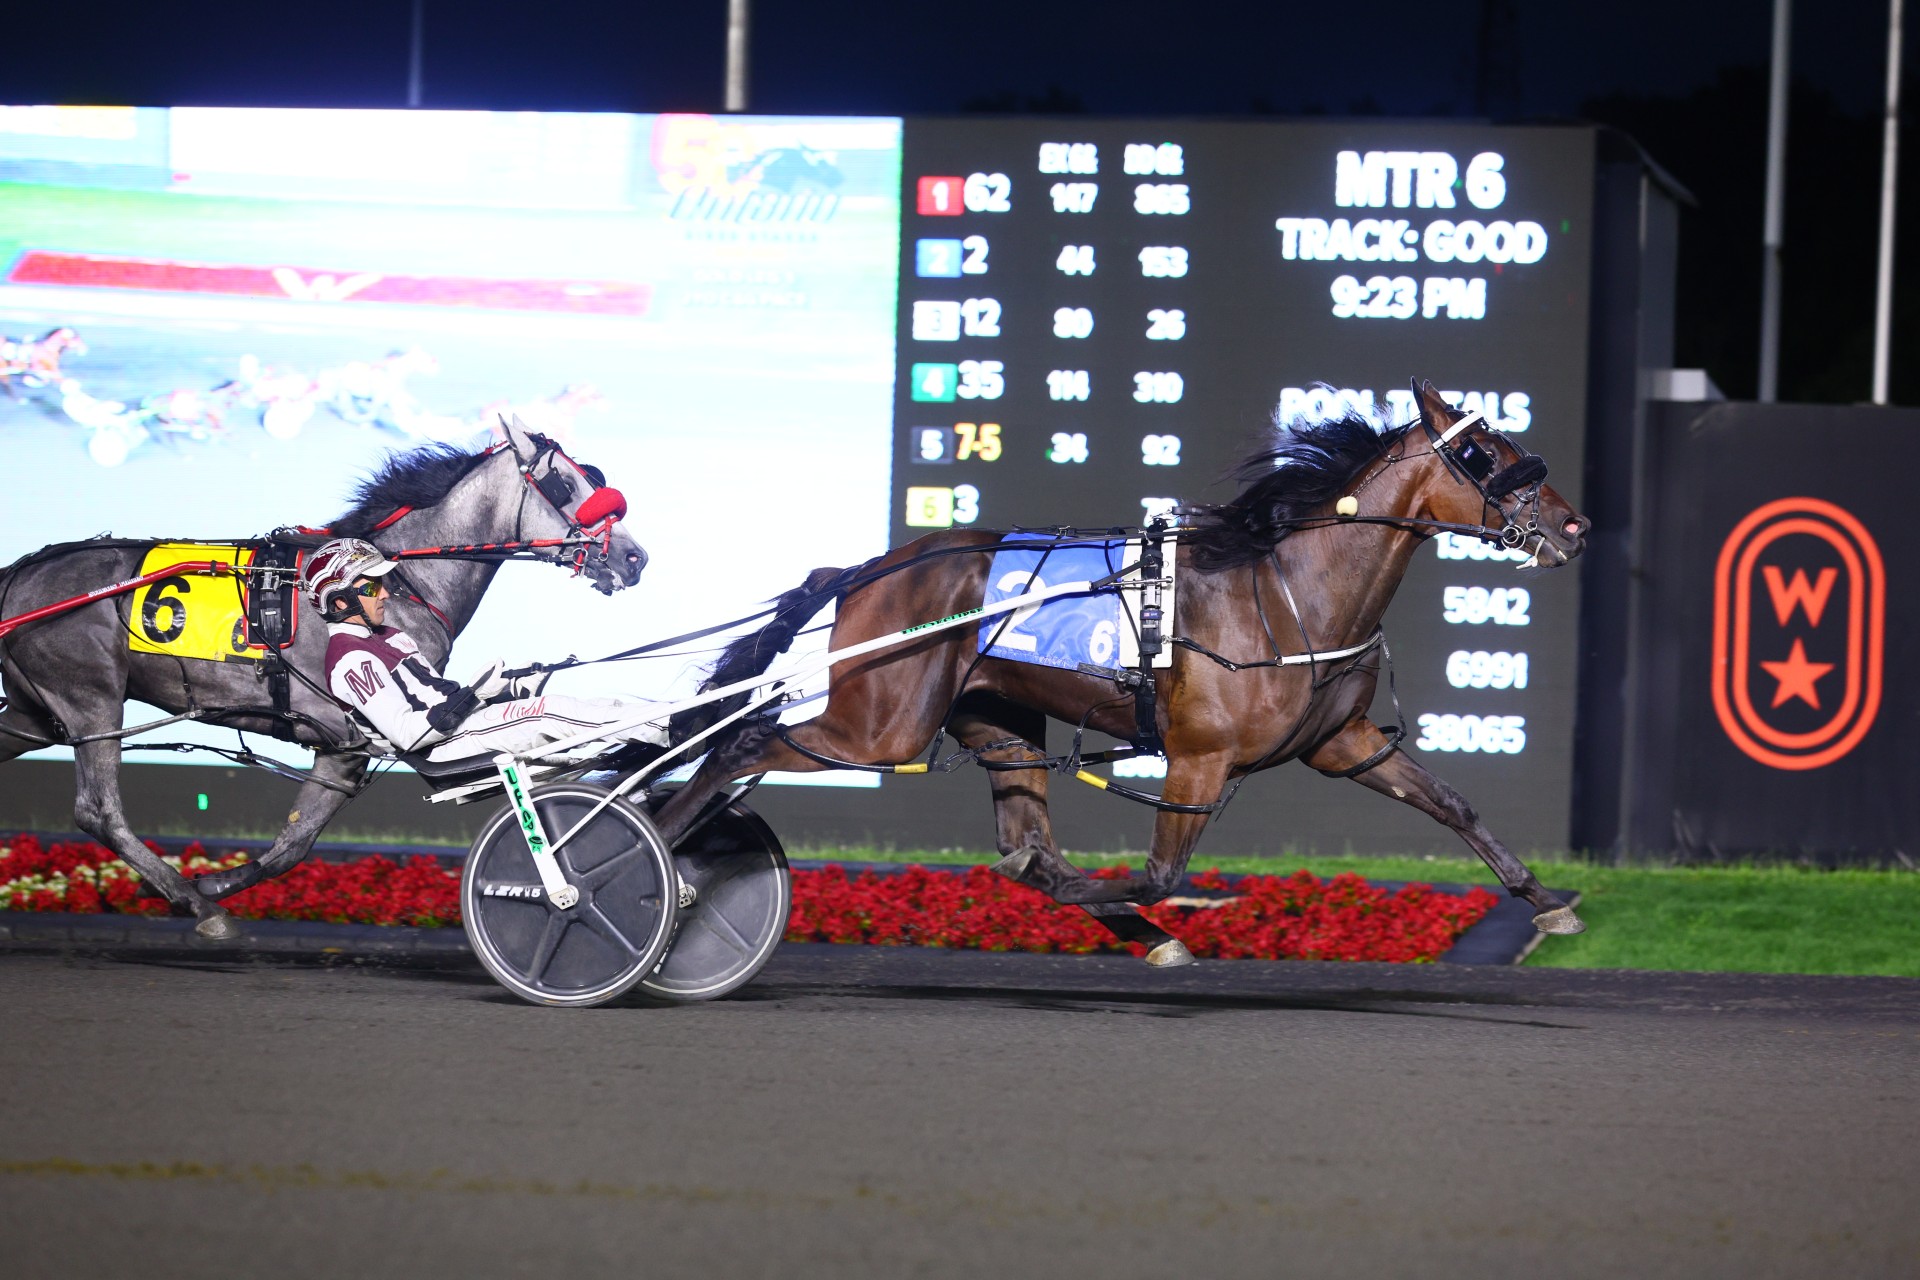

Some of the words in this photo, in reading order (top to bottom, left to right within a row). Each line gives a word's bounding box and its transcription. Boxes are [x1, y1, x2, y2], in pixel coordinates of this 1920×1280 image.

[932, 181, 949, 211] 1
[964, 173, 1011, 211] 62
[1050, 183, 1098, 212] 147
[1335, 151, 1457, 208] MTR
[1466, 152, 1506, 209] 6
[962, 236, 989, 274] 2
[1276, 218, 1418, 261] TRACK:
[1423, 220, 1548, 263] GOOD
[928, 245, 950, 275] 2
[1057, 245, 1095, 275] 44
[1139, 247, 1188, 277] 153
[1331, 275, 1417, 318] 9:23
[1423, 278, 1486, 318] PM
[961, 298, 1001, 336] 12
[920, 367, 945, 398] 4
[957, 360, 1003, 399] 35
[1047, 370, 1089, 400] 114
[1133, 372, 1183, 402] 310
[1386, 389, 1531, 432] TTALS
[921, 429, 944, 460] 5
[955, 423, 1001, 461] 7-5
[1051, 433, 1088, 463] 34
[1142, 435, 1180, 465] 92
[923, 496, 937, 518] 6
[953, 485, 979, 523] 3
[142, 576, 191, 643] 6
[984, 571, 1046, 651] 2
[1443, 587, 1529, 625] 5842
[1762, 565, 1838, 628] W
[1089, 620, 1116, 664] 6
[344, 660, 385, 705] M
[1446, 651, 1527, 688] 6991
[1416, 714, 1525, 753] 38065
